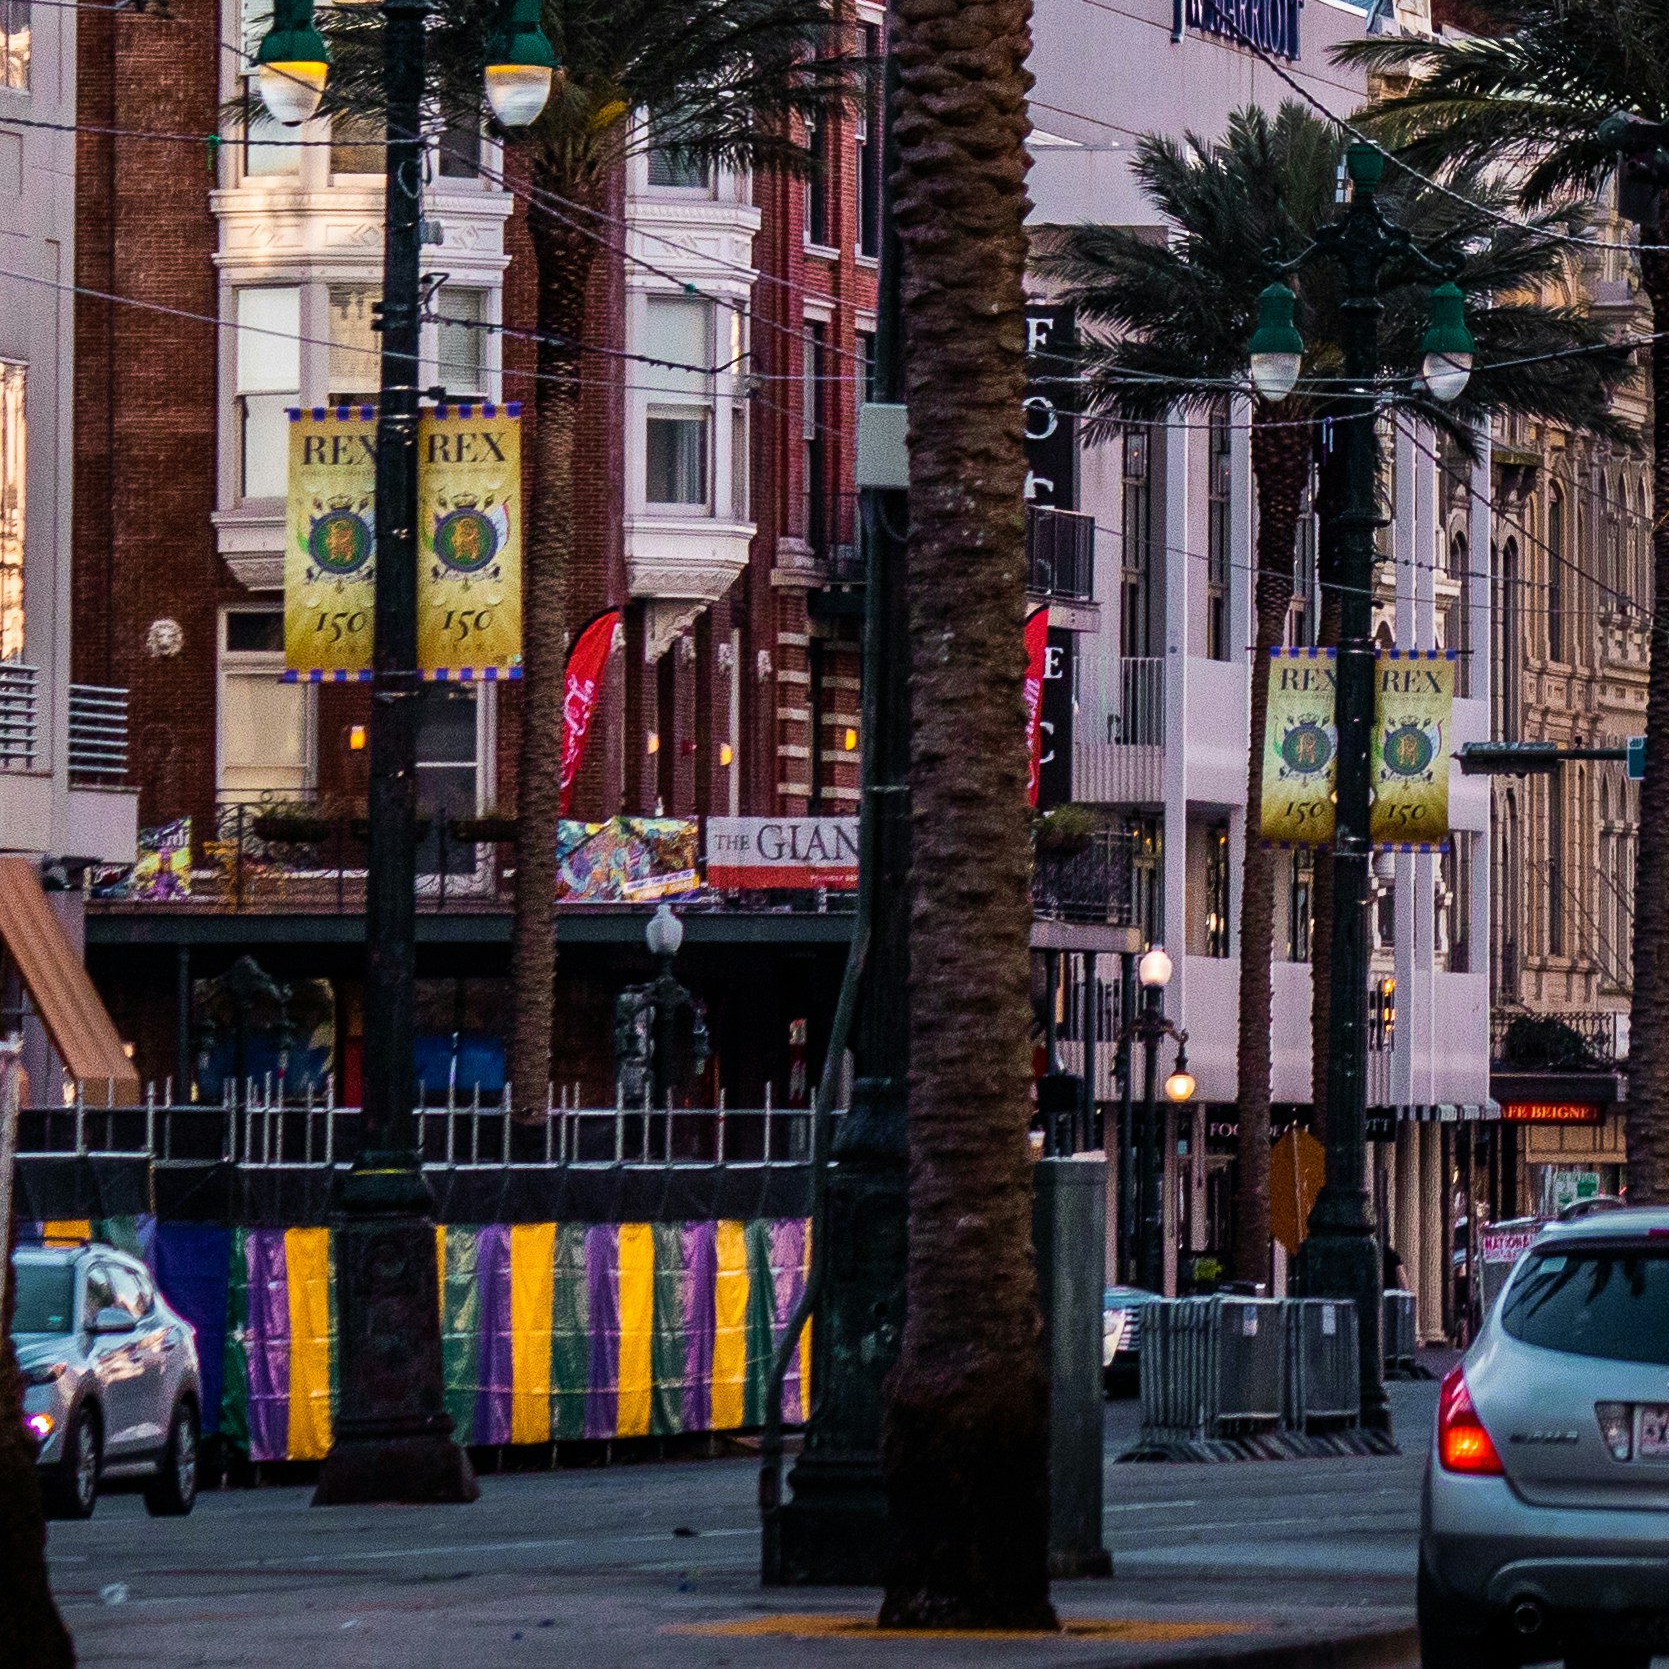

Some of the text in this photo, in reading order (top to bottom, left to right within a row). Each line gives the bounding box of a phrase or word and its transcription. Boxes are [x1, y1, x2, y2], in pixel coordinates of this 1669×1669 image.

[304, 434, 377, 466] REX
[425, 432, 506, 464] REX
[315, 610, 367, 643] 150
[441, 609, 494, 642] 150
[1381, 669, 1443, 694] REX
[1284, 801, 1326, 825] 150
[1387, 803, 1427, 826] 150
[714, 823, 860, 861] THE GIAN
